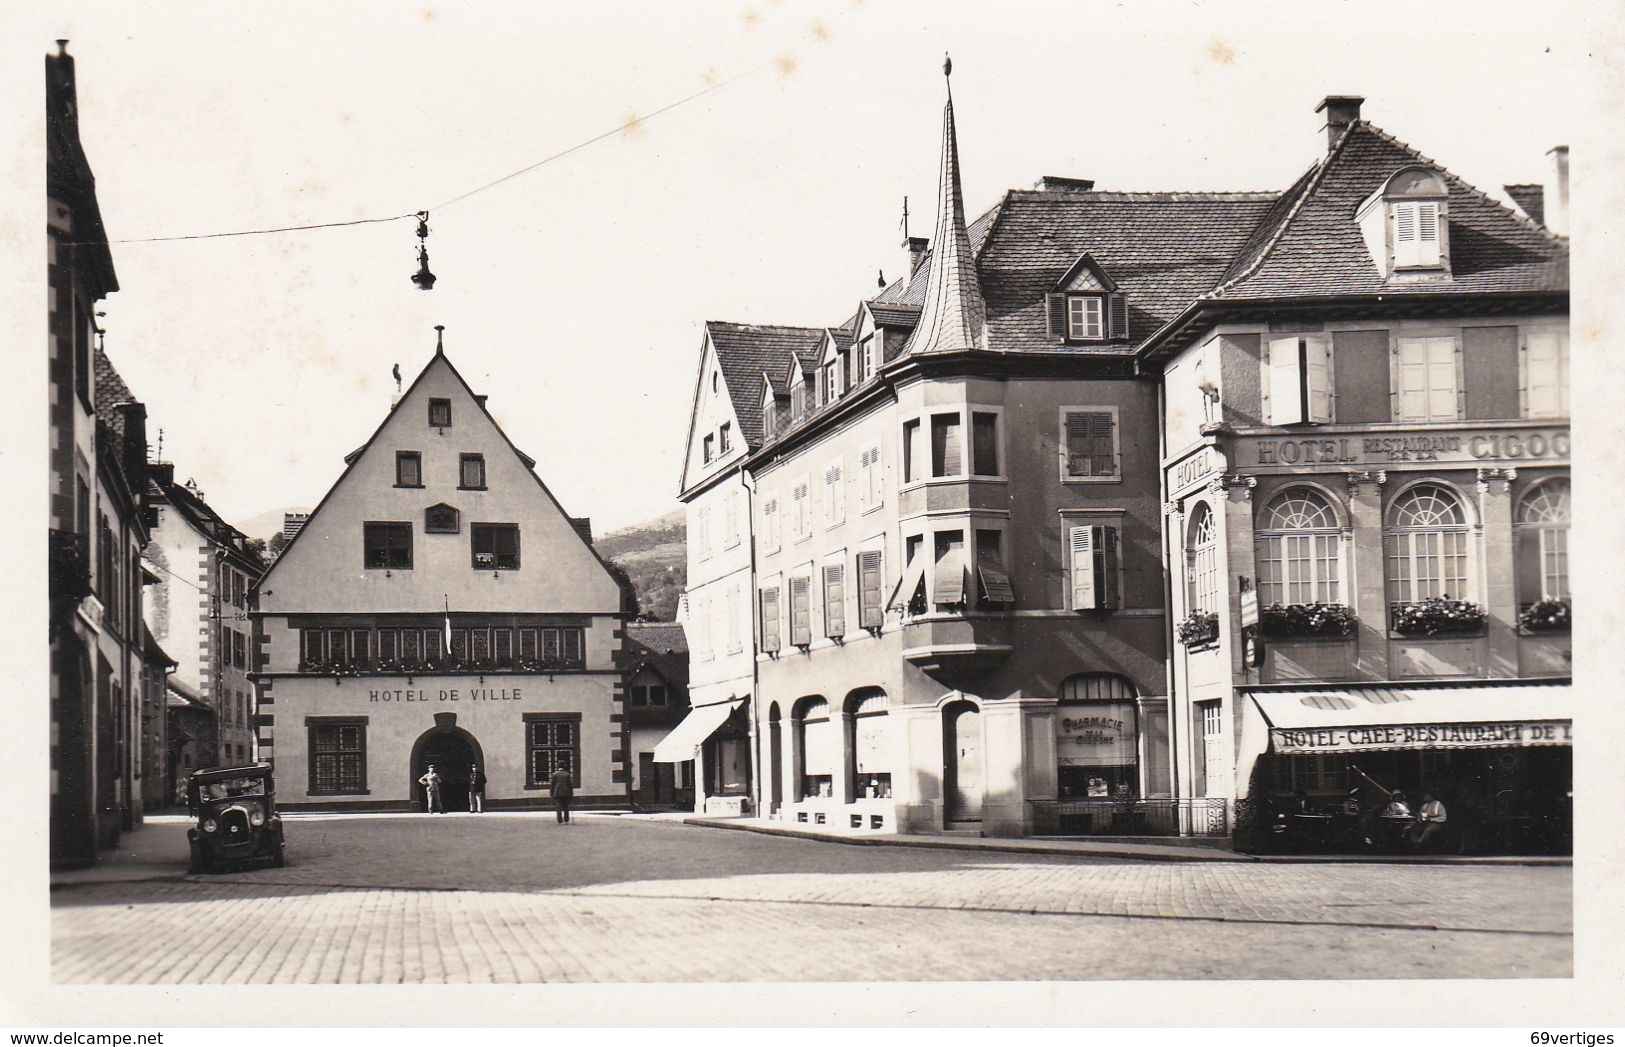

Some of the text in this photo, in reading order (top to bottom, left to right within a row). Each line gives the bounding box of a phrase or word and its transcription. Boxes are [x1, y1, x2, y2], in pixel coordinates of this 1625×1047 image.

[1257, 438, 1357, 464] HOTEL
[1362, 436, 1460, 453] RESTAURANT
[1387, 450, 1438, 461] DE LA
[1177, 451, 1212, 488] HOTEL
[369, 688, 522, 702] HOTEL DE VILLE
[1531, 724, 1556, 740] DE
